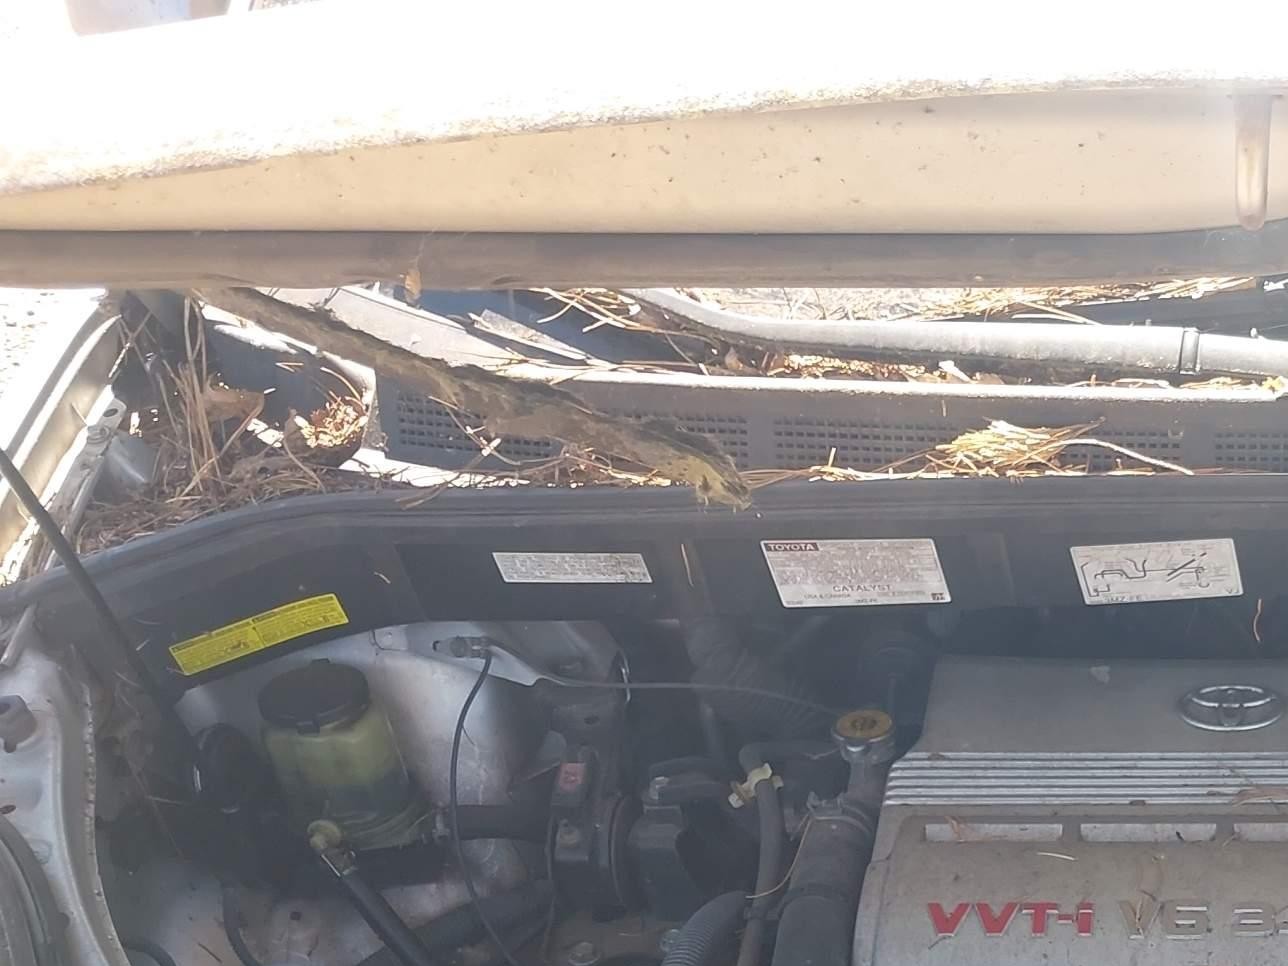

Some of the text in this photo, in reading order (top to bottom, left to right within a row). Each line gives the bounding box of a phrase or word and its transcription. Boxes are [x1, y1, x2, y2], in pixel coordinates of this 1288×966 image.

[768, 543, 815, 551] TOYOTA
[832, 584, 891, 593] CATALYST
[1119, 898, 1210, 940] V6
